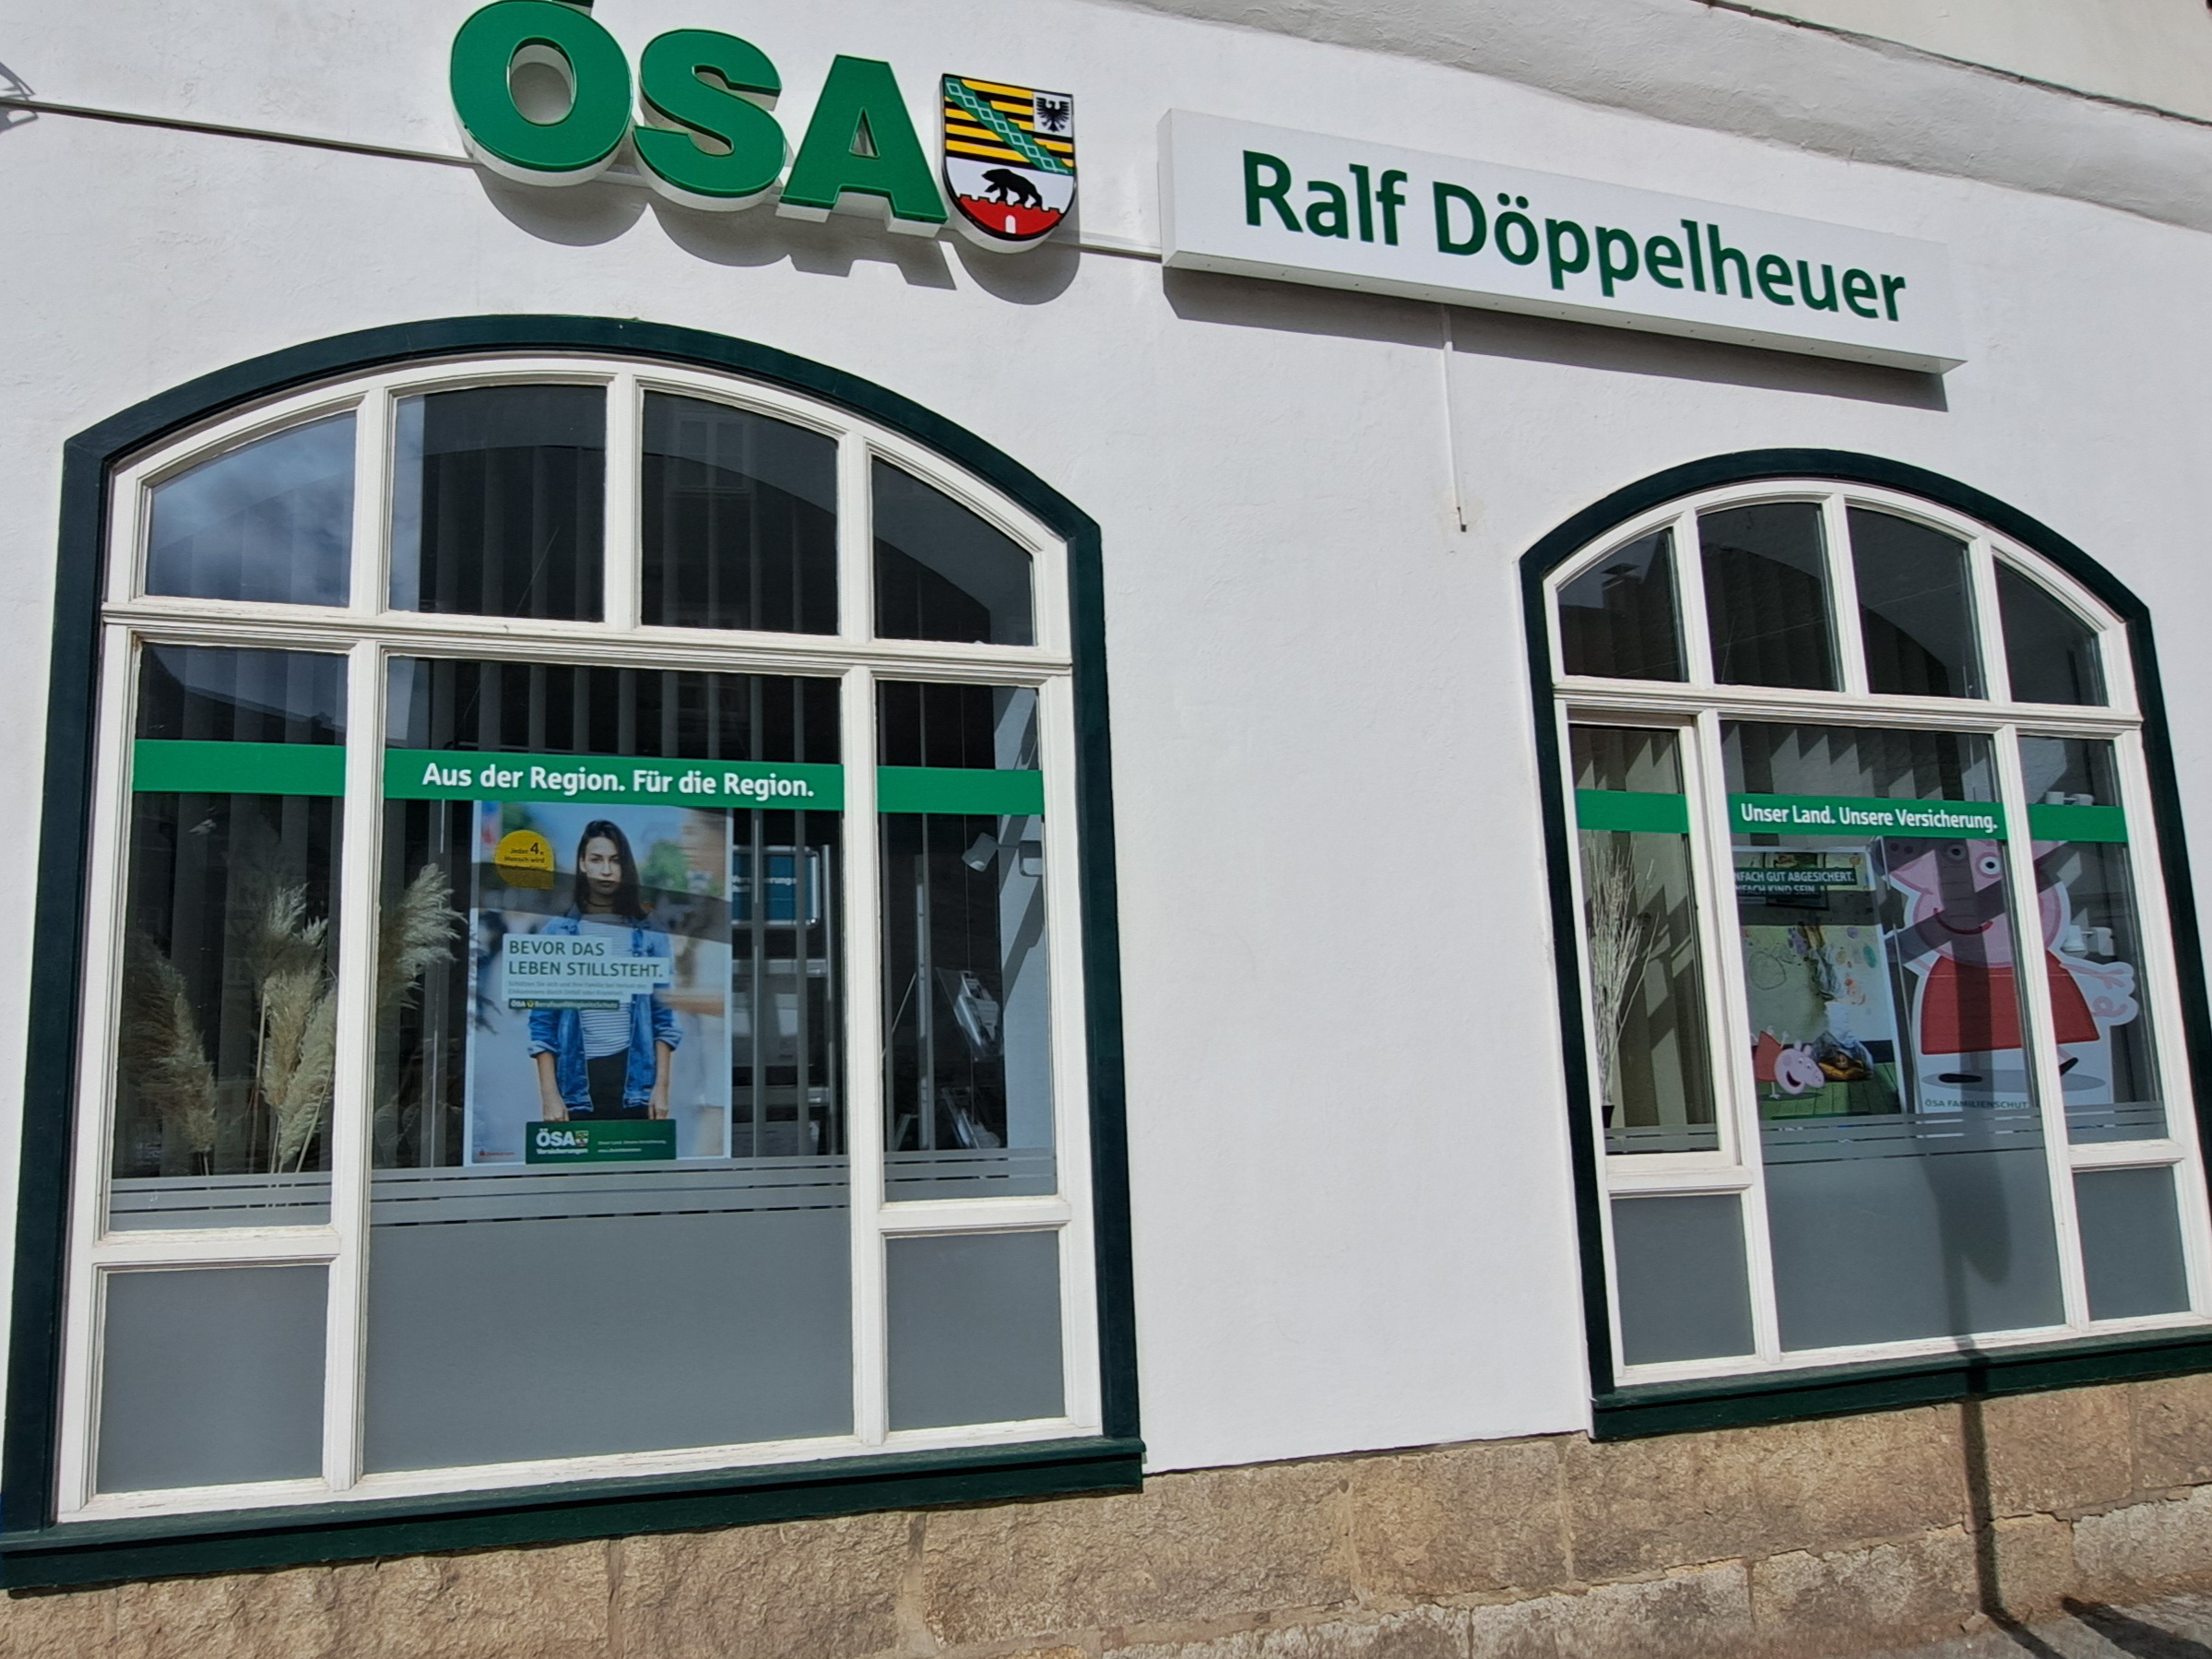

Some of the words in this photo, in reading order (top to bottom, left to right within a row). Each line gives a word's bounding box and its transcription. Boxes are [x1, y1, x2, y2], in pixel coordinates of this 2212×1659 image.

[1242, 149, 1408, 247] Ralf
[1433, 180, 1907, 323] Döppelheuer
[422, 762, 472, 787] Aus
[479, 764, 524, 789] der
[529, 766, 626, 796] Region.
[633, 769, 673, 793] Für
[679, 770, 716, 795] die
[724, 773, 815, 801] Region.
[1741, 803, 1789, 823] Unser
[1792, 804, 1836, 824] Land.
[1839, 807, 1893, 826] Unsere
[1895, 809, 1998, 833] Versicherung.
[529, 842, 544, 855] 4.
[1766, 871, 1786, 882] GUT
[1788, 871, 1855, 883] ABGESICHERT.
[1768, 884, 1792, 895] KIND
[509, 941, 566, 955] BEVOR
[572, 942, 605, 956] DAS
[508, 961, 561, 975] LEBEN
[566, 962, 664, 978] STILLSTEHT.
[1924, 1098, 1945, 1108] ÖSA
[536, 1128, 576, 1146] ÖSA
